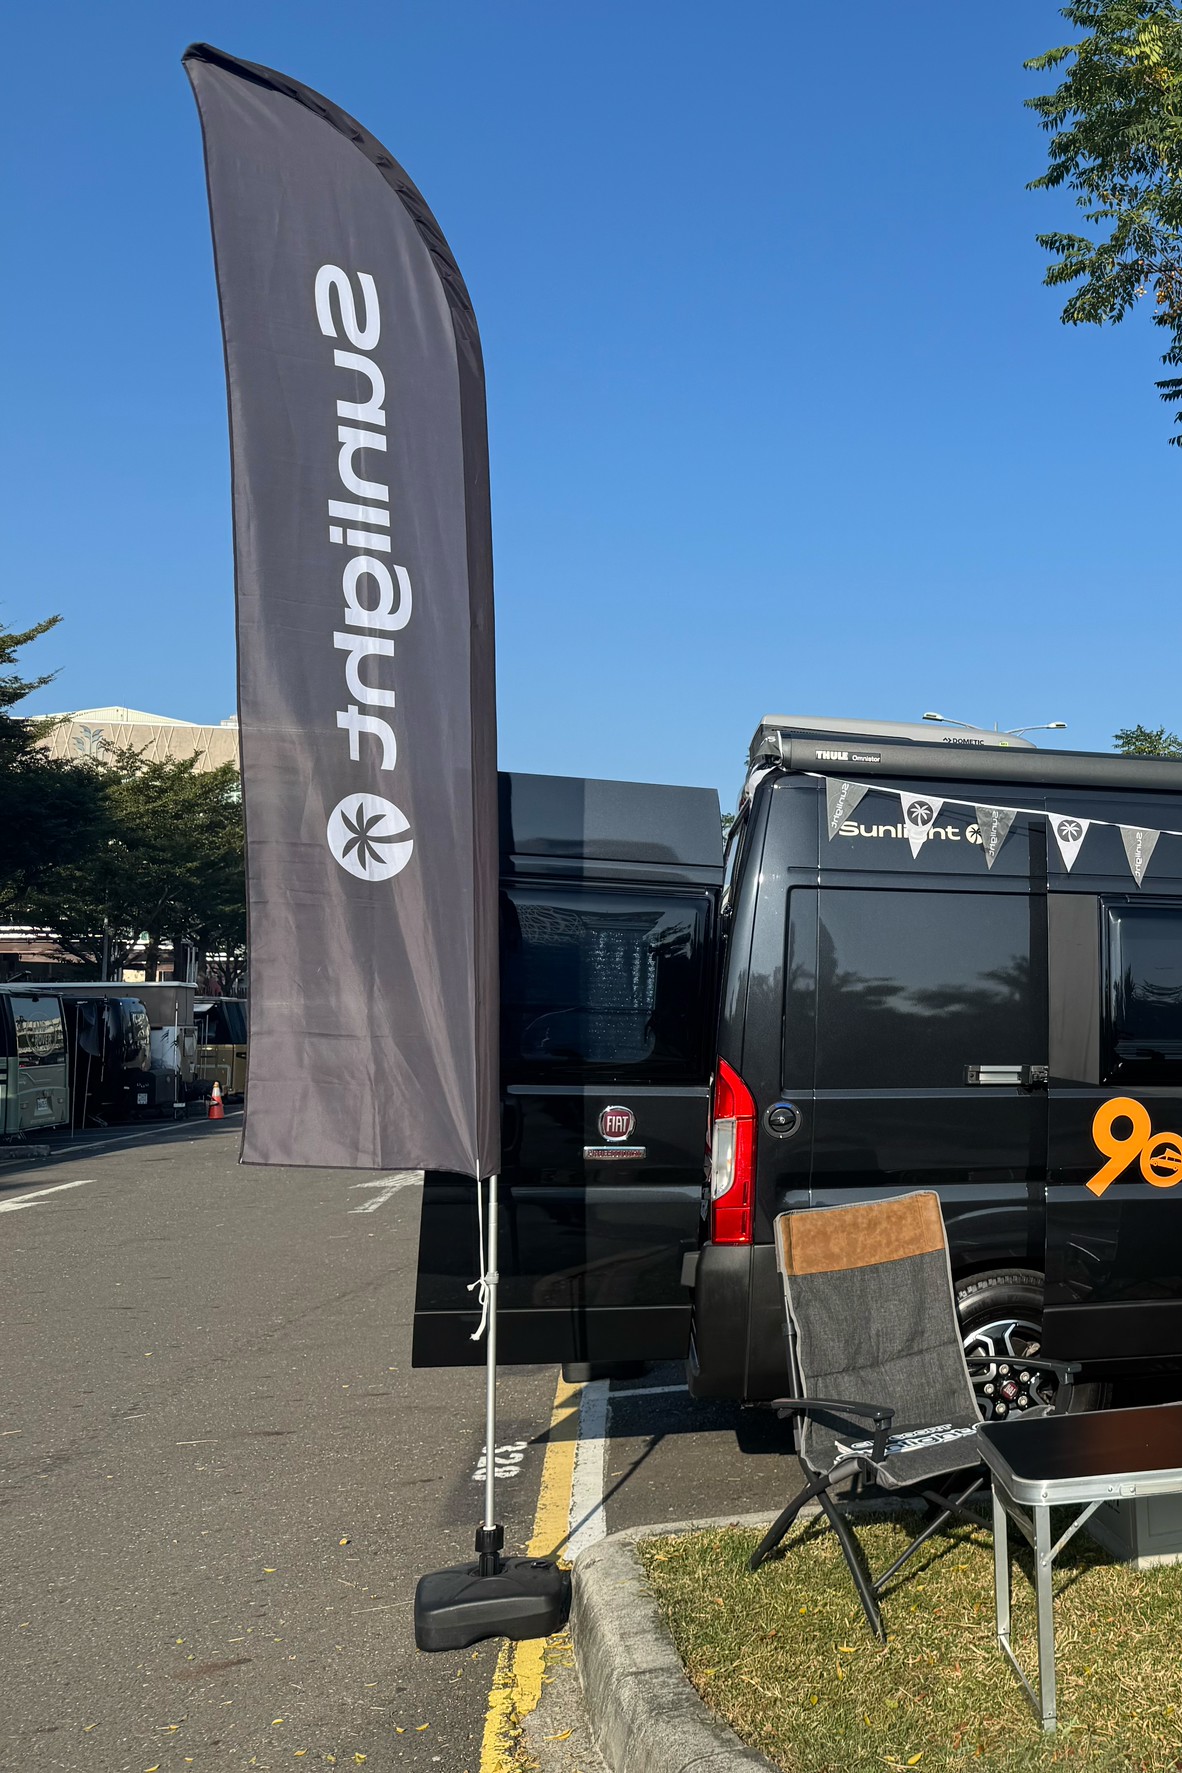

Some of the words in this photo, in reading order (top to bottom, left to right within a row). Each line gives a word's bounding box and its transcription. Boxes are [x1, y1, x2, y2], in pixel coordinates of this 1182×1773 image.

[952, 737, 985, 745] DOMETIC
[816, 750, 849, 760] THULE
[606, 1115, 629, 1132] FIAT
